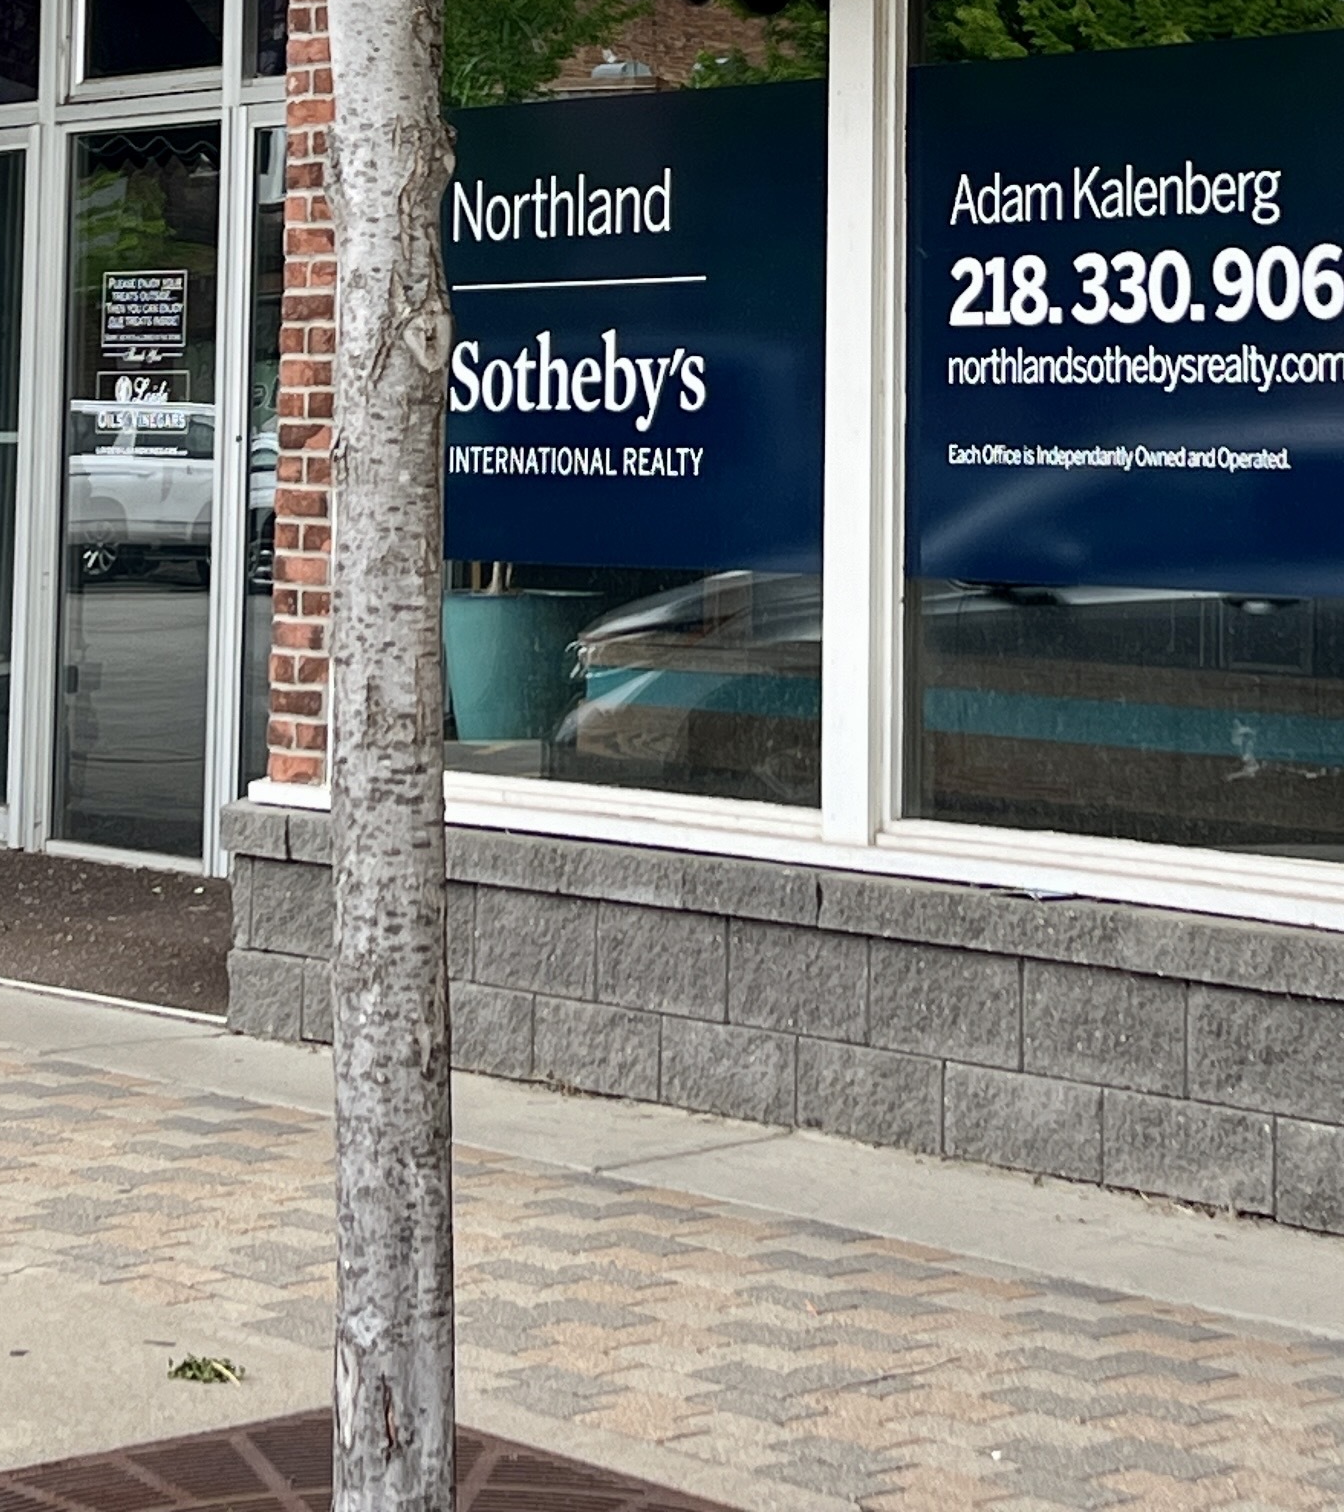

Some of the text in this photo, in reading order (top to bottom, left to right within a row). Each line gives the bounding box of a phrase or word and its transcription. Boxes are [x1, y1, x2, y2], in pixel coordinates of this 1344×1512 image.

[452, 168, 672, 242] Northland
[950, 160, 1282, 226] Adam Kalenberg
[449, 329, 706, 433] Sotheby's
[448, 446, 703, 477] INTERNATIONAL REALTY
[948, 444, 981, 465] Each
[982, 444, 1022, 465] Office
[1023, 445, 1035, 465] is
[1135, 445, 1186, 467] Owned
[1187, 446, 1216, 468] and
[1217, 446, 1291, 472] Operated.
